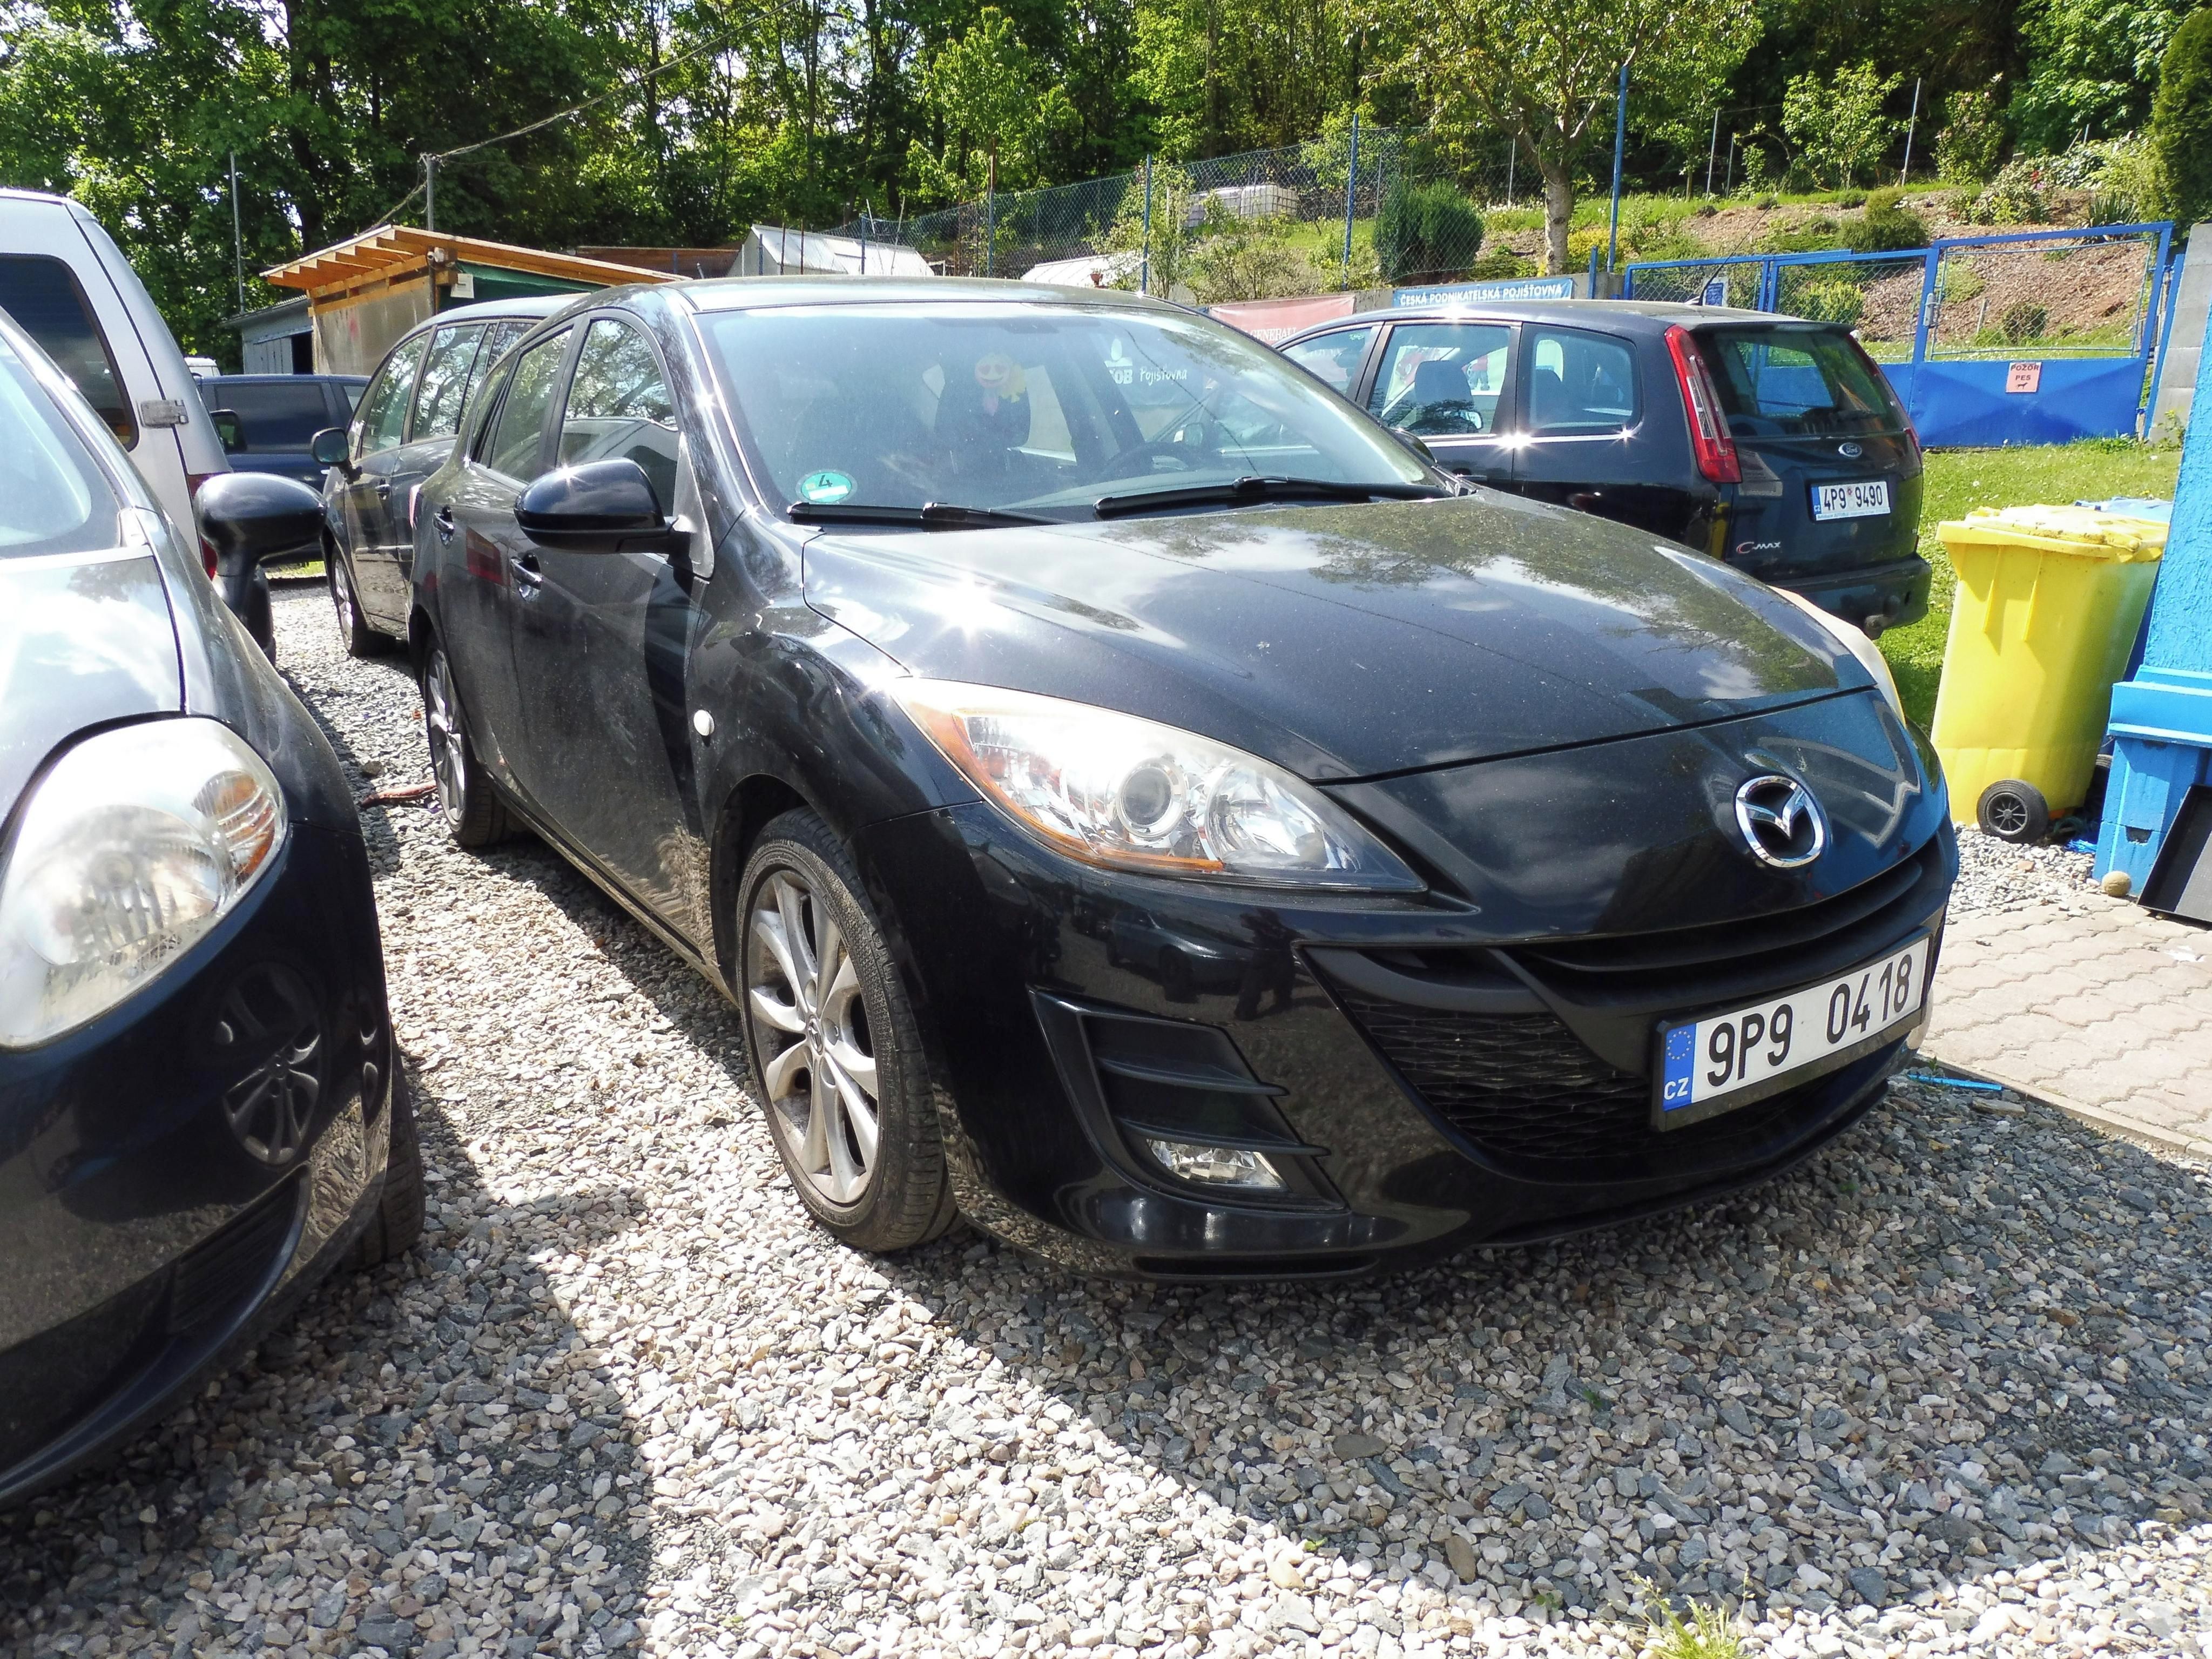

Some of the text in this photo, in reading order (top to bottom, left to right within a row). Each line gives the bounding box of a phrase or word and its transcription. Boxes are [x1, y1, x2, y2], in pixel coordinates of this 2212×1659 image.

[1400, 284, 1562, 306] ČESKÁ PODNIKATELSKÁ POJIŠŤOVNA
[819, 474, 833, 487] 4
[1824, 485, 1883, 510] 4P9 9490
[1707, 953, 1913, 1087] 9P9 0418
[1663, 1077, 1689, 1101] CZ
